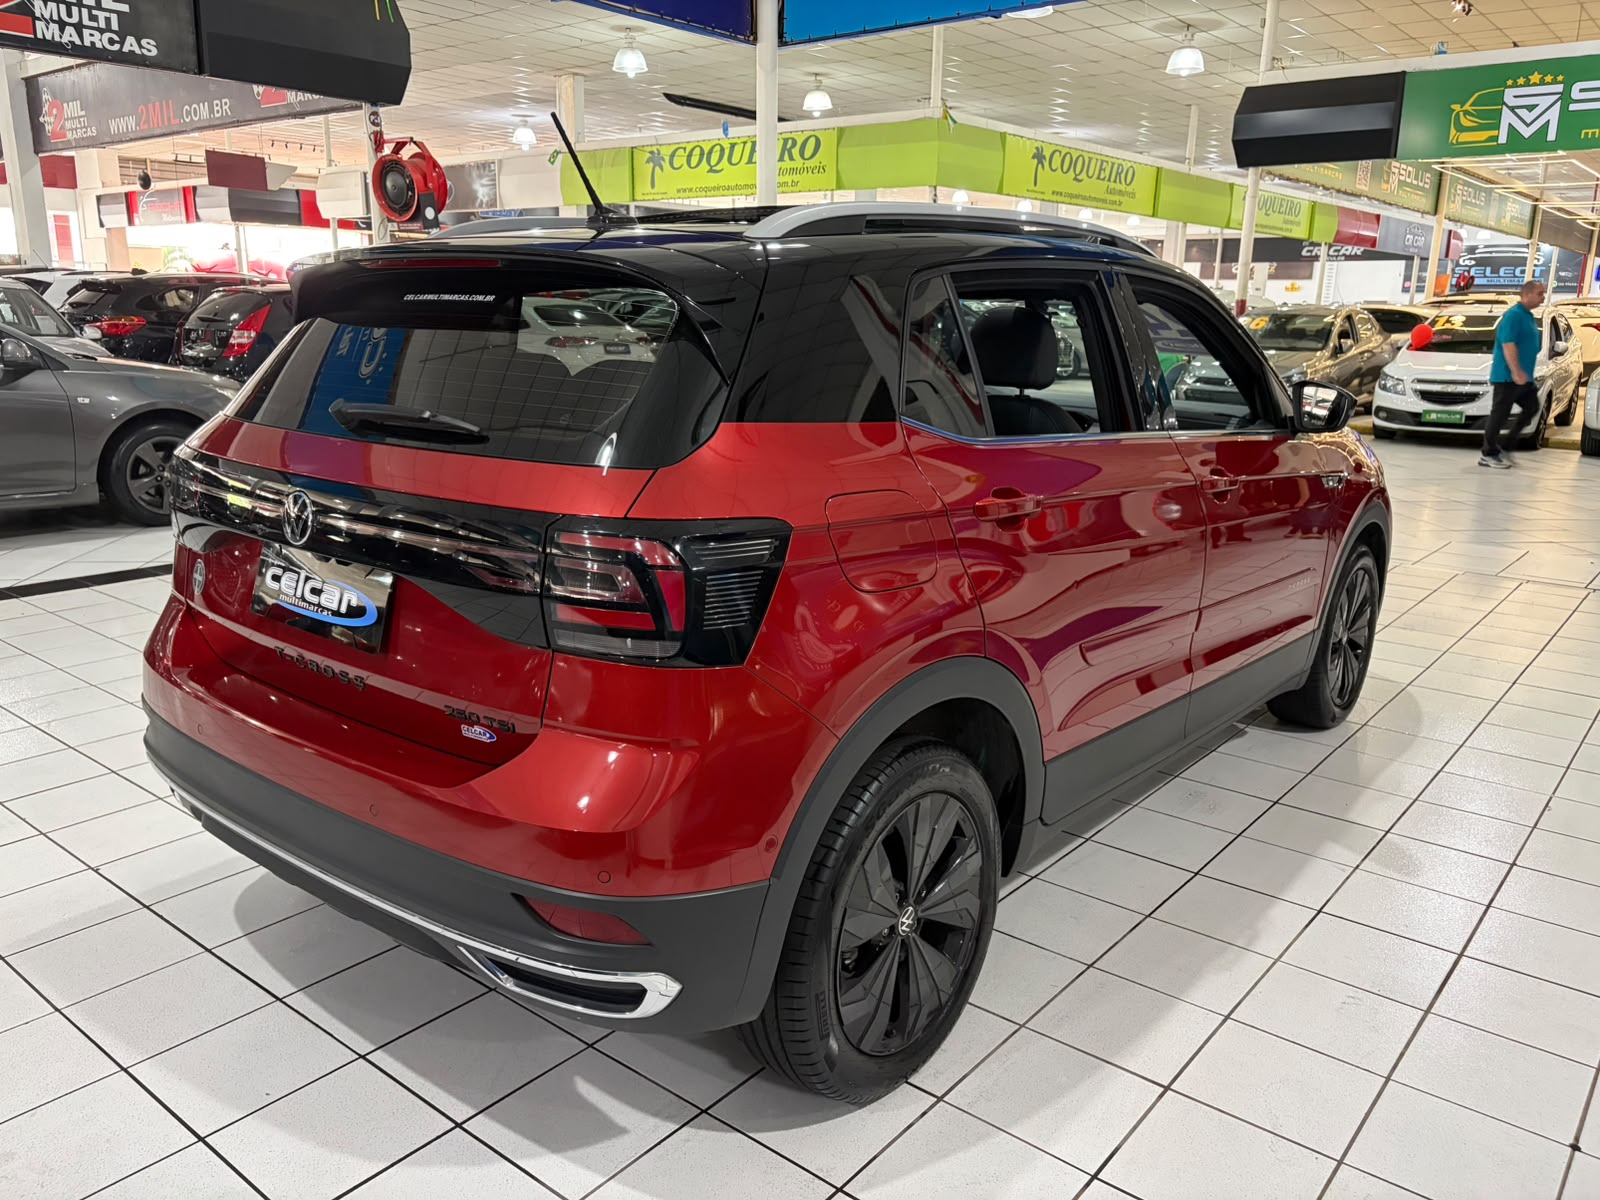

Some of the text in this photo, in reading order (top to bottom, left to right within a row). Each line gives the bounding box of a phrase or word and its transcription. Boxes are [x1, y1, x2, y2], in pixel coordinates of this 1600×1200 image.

[34, 2, 119, 31] MULTI
[35, 20, 158, 57] MARCAS
[63, 100, 86, 118] MIL
[108, 98, 231, 135] WWW.2MIL.COM.BR
[64, 117, 88, 129] MULTI
[66, 127, 97, 140] MARCAS
[668, 134, 822, 174] COQUERO
[777, 160, 827, 177] tomóveis
[1048, 149, 1136, 187] COQUEIRO
[1399, 161, 1432, 189] SOLUS
[1257, 193, 1302, 218] OQUEIRO
[1328, 246, 1364, 256] CAR
[403, 293, 496, 303] CELCARMULTIMARCAS.COM.BR
[265, 566, 358, 614] celcar
[279, 593, 333, 617] multimarcas
[274, 645, 366, 692] T-CROSS
[444, 704, 517, 734] 250 TSI
[462, 725, 488, 737] CELCAR
